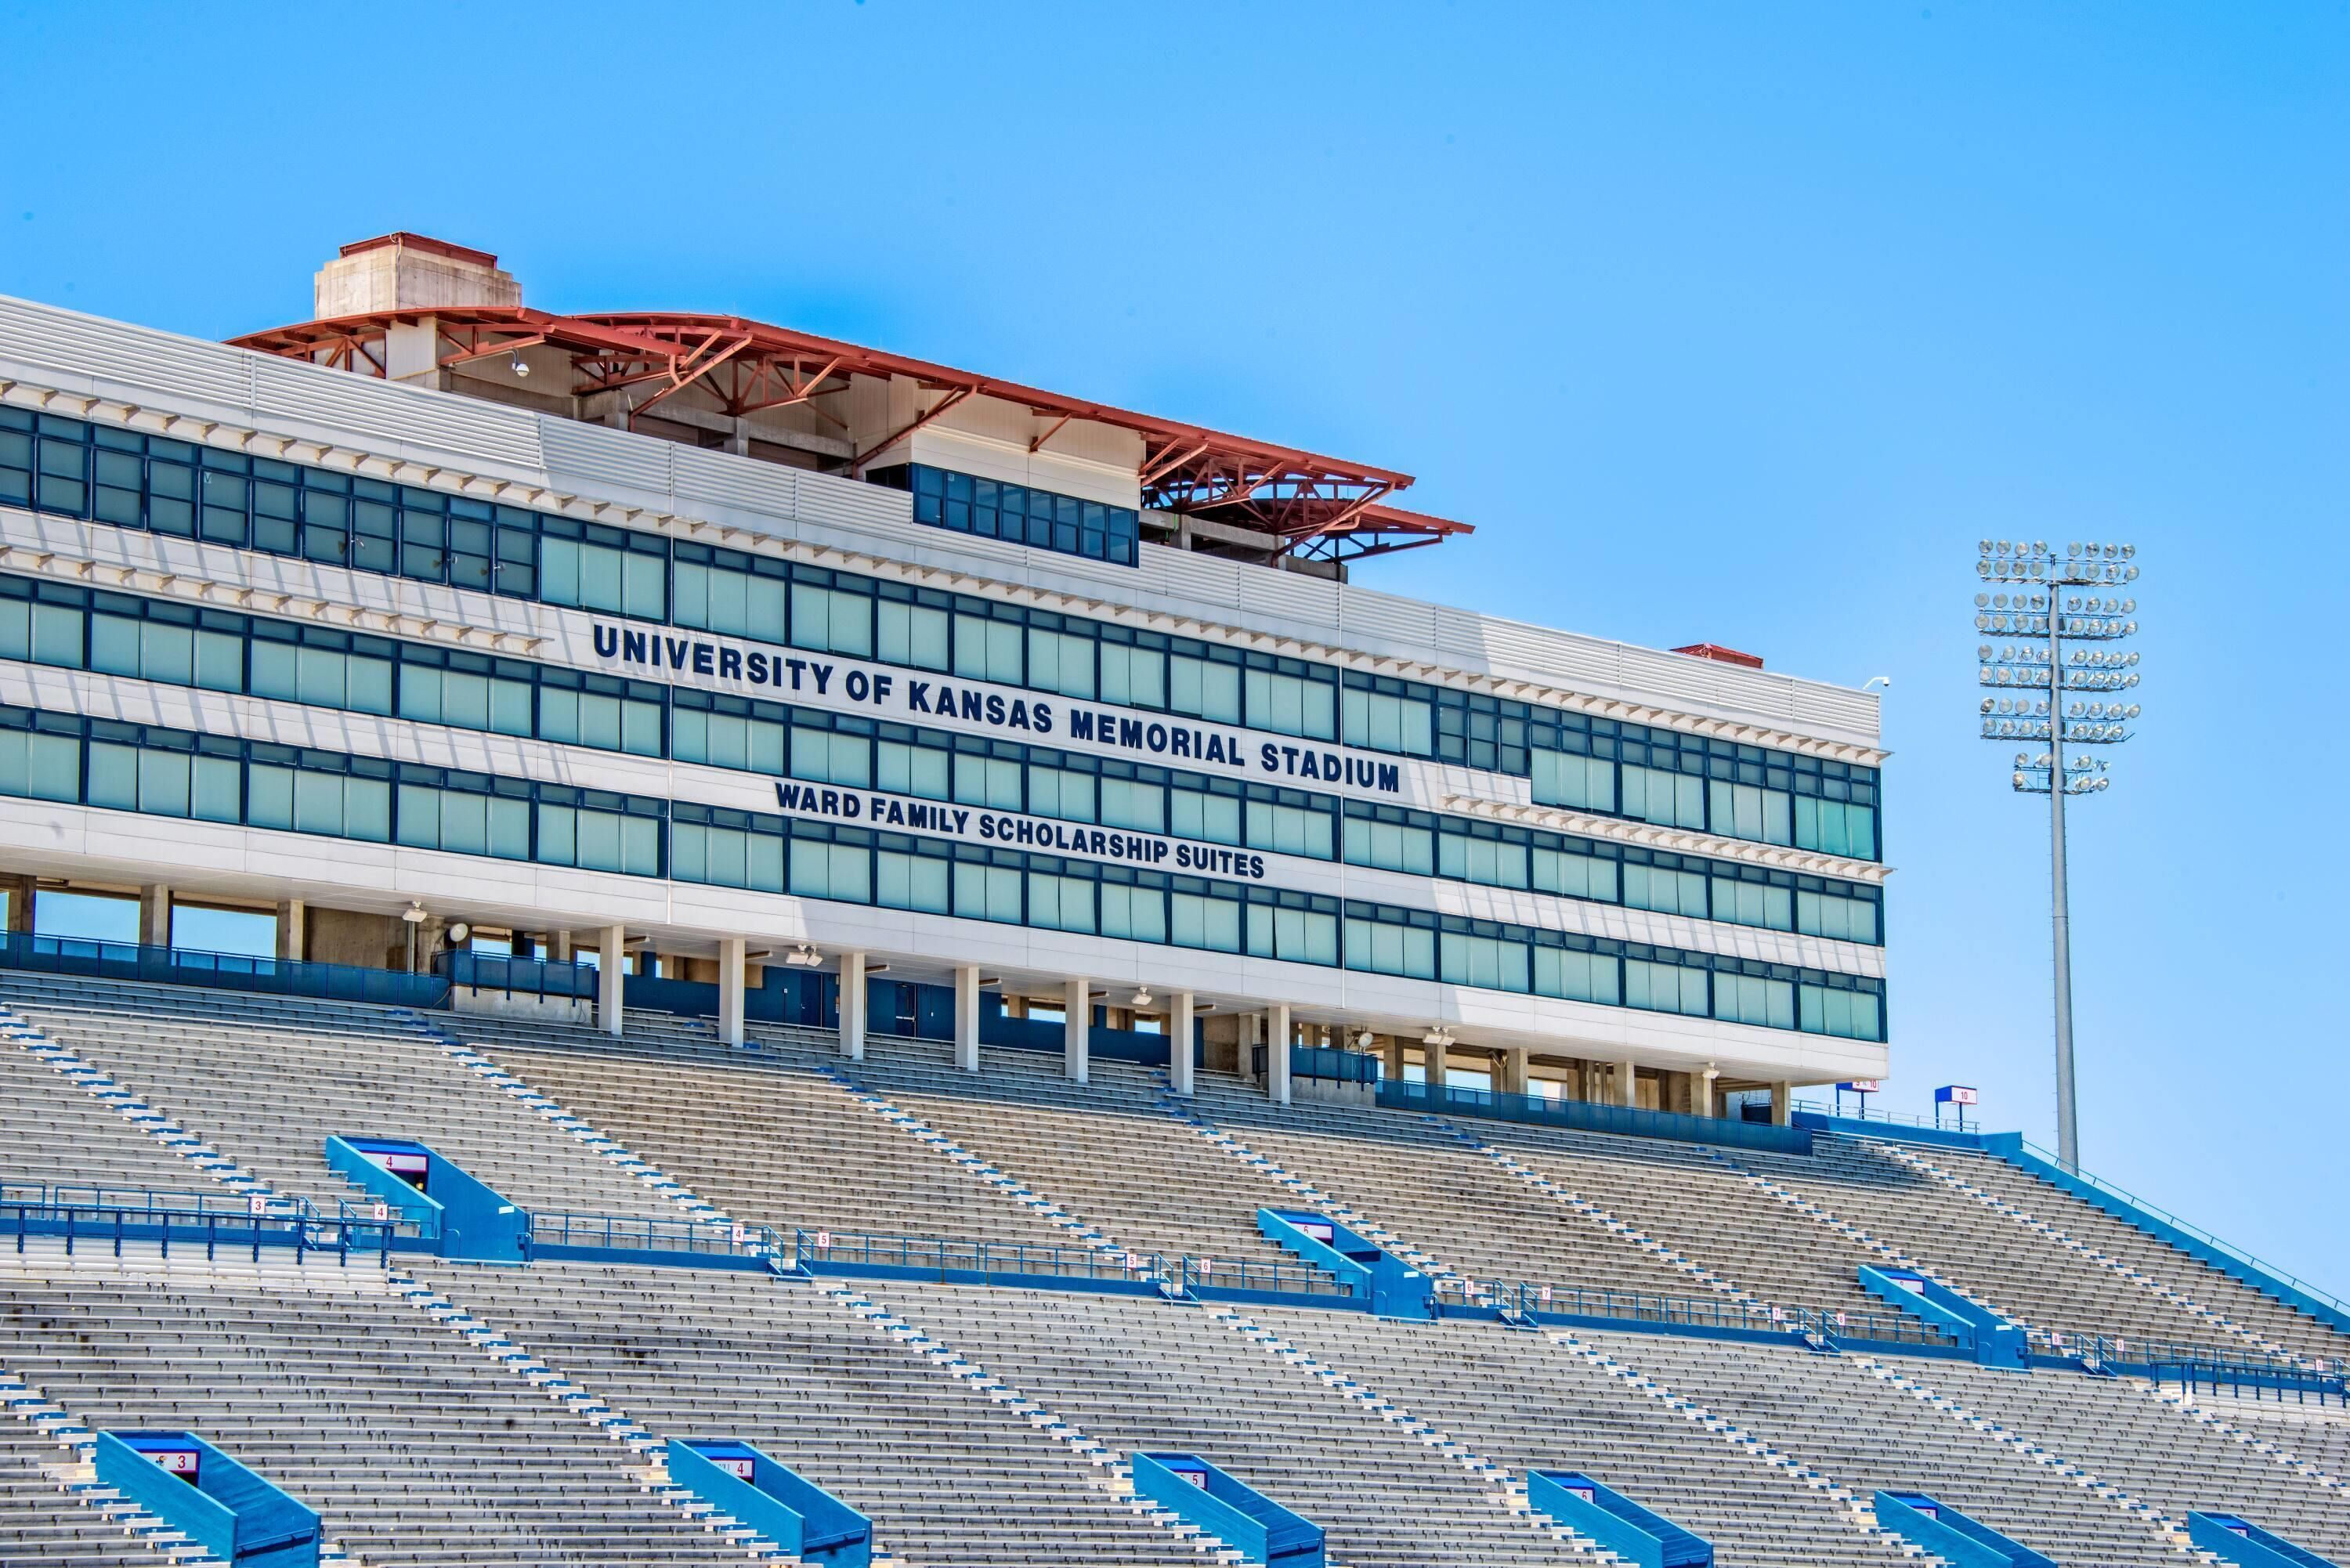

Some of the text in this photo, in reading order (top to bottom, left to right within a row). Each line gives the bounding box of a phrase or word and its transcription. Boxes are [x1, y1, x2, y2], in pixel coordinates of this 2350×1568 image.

[593, 623, 1400, 793] UNIVERSITY OF KANSAS MEMORIAL STADIUM
[775, 782, 1265, 879] WARD FAMILY SCHOLARSHIP SUITES
[1961, 1091, 1968, 1100] 10
[386, 1155, 393, 1168] 4
[255, 1201, 261, 1211] 3
[378, 1208, 384, 1217] 4
[736, 1230, 741, 1238] 4
[821, 1235, 826, 1245] 5
[1130, 1256, 1134, 1266] 5
[1204, 1262, 1209, 1270] 6
[1467, 1283, 1472, 1292] 6
[177, 1455, 186, 1469] 3
[737, 1462, 743, 1475] 4
[1192, 1475, 1198, 1486] 5
[1582, 1490, 1587, 1500] 6
